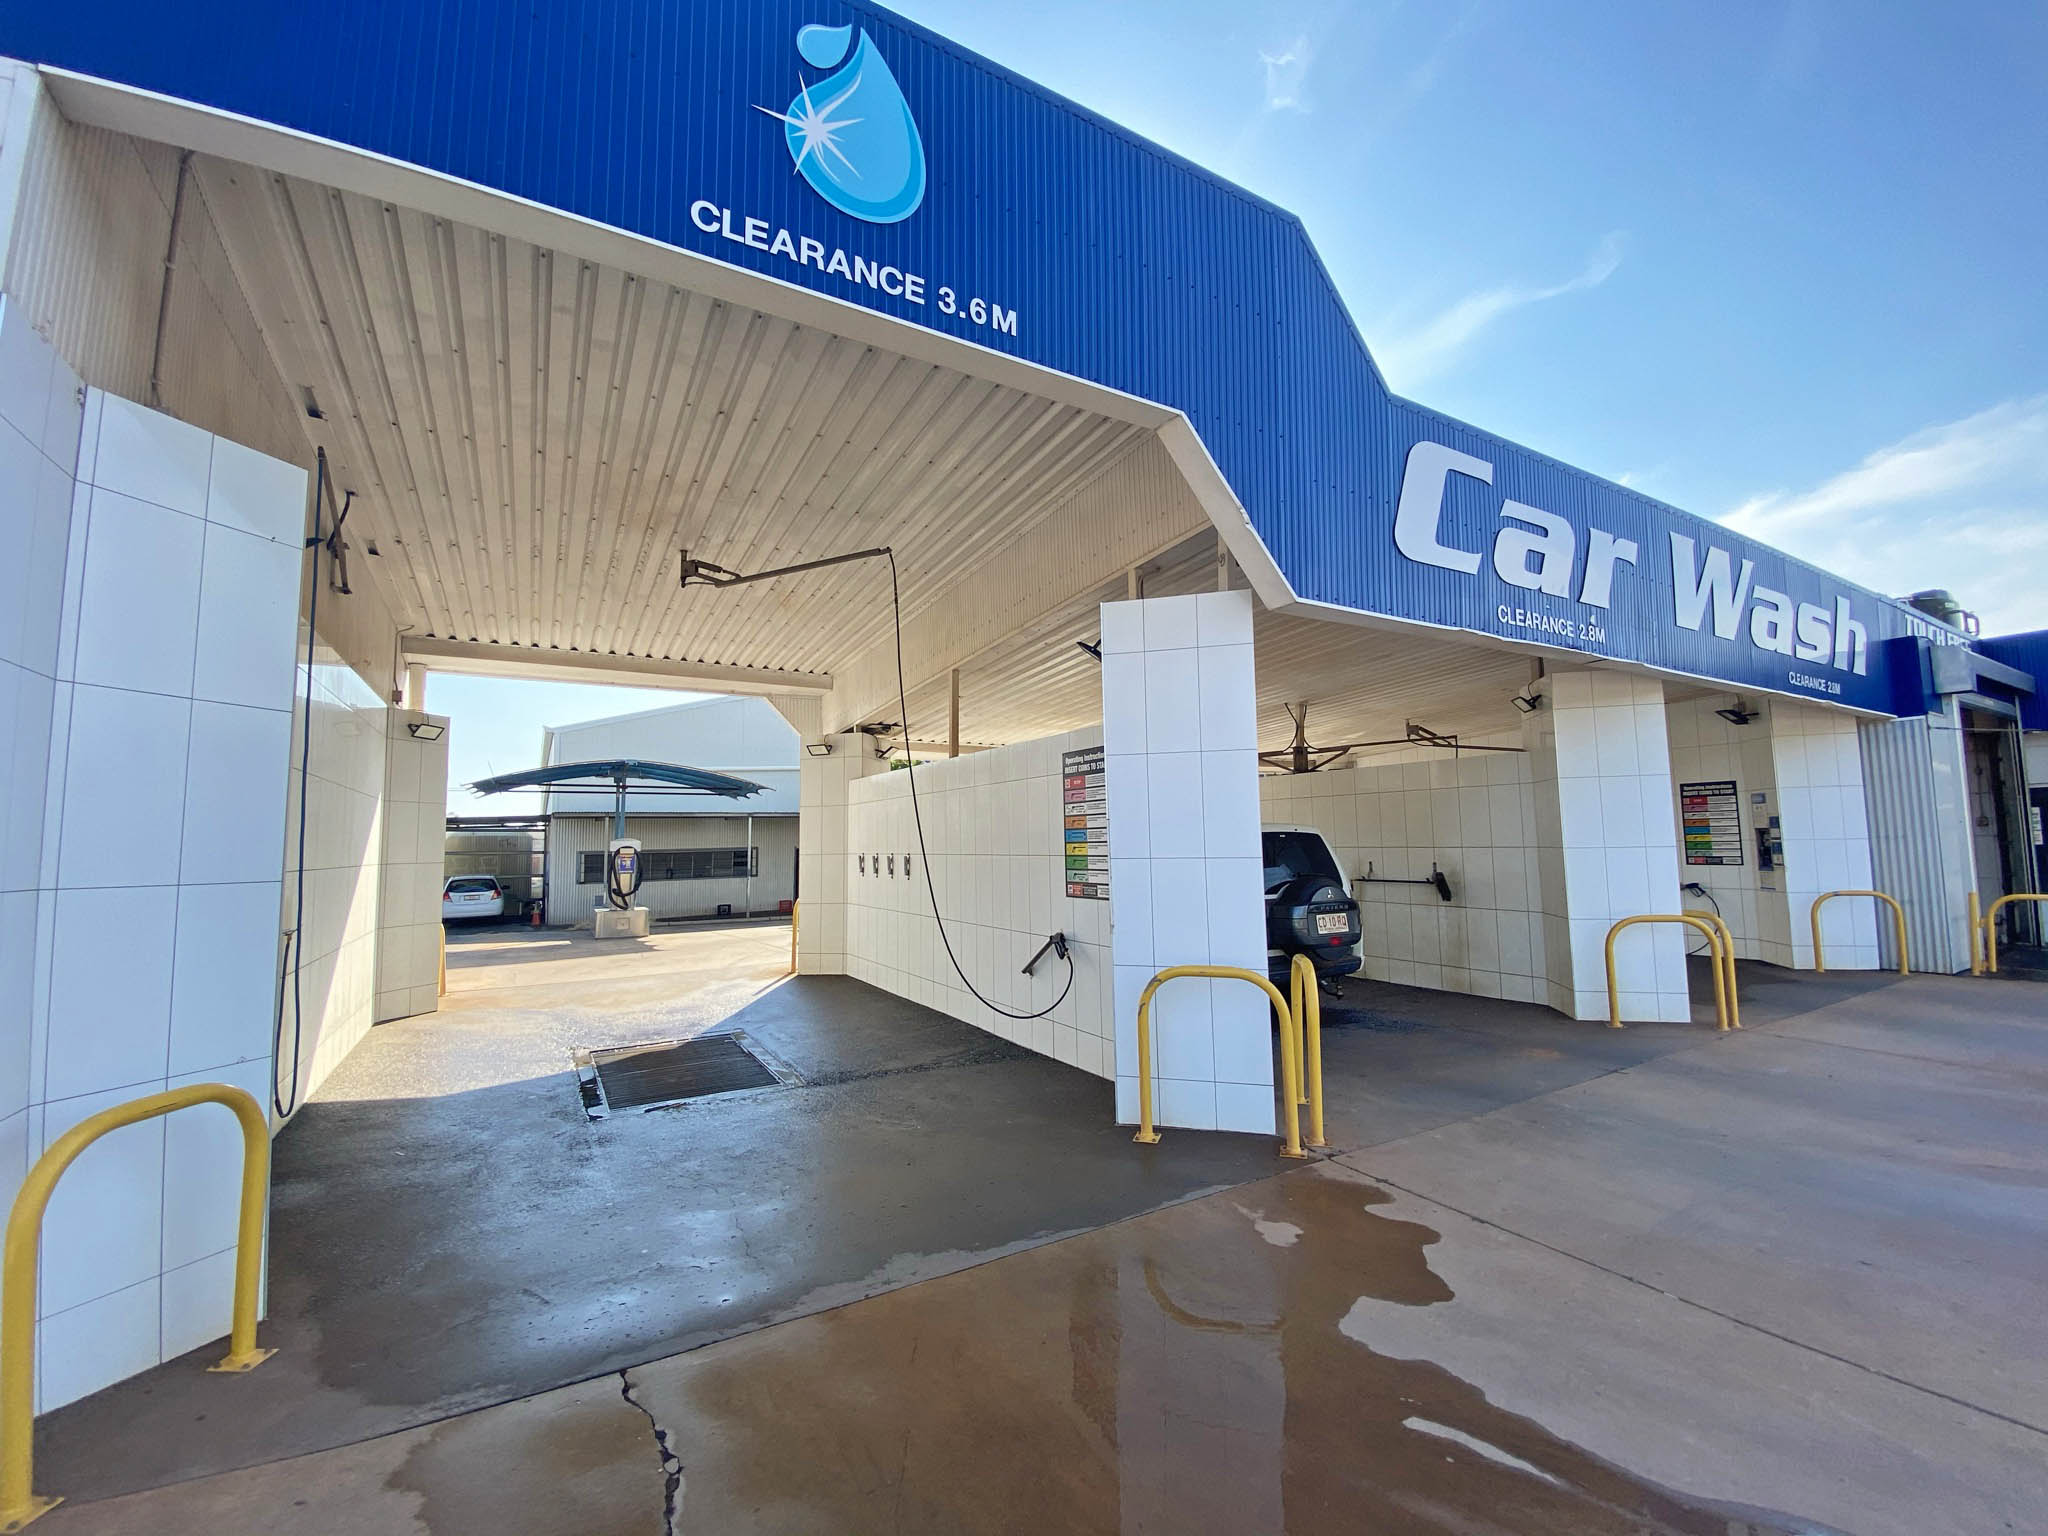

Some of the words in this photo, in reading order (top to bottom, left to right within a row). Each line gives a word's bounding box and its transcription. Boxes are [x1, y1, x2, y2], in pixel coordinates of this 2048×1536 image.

[690, 200, 925, 305] CLEARANCE
[937, 286, 1017, 336] 3.6M
[1394, 440, 1638, 609] Car
[1669, 531, 1867, 677] Wash
[1497, 605, 1575, 638] CLEARANCE
[1579, 624, 1606, 644] 2.8M
[1788, 671, 1827, 692] CLEARANCE
